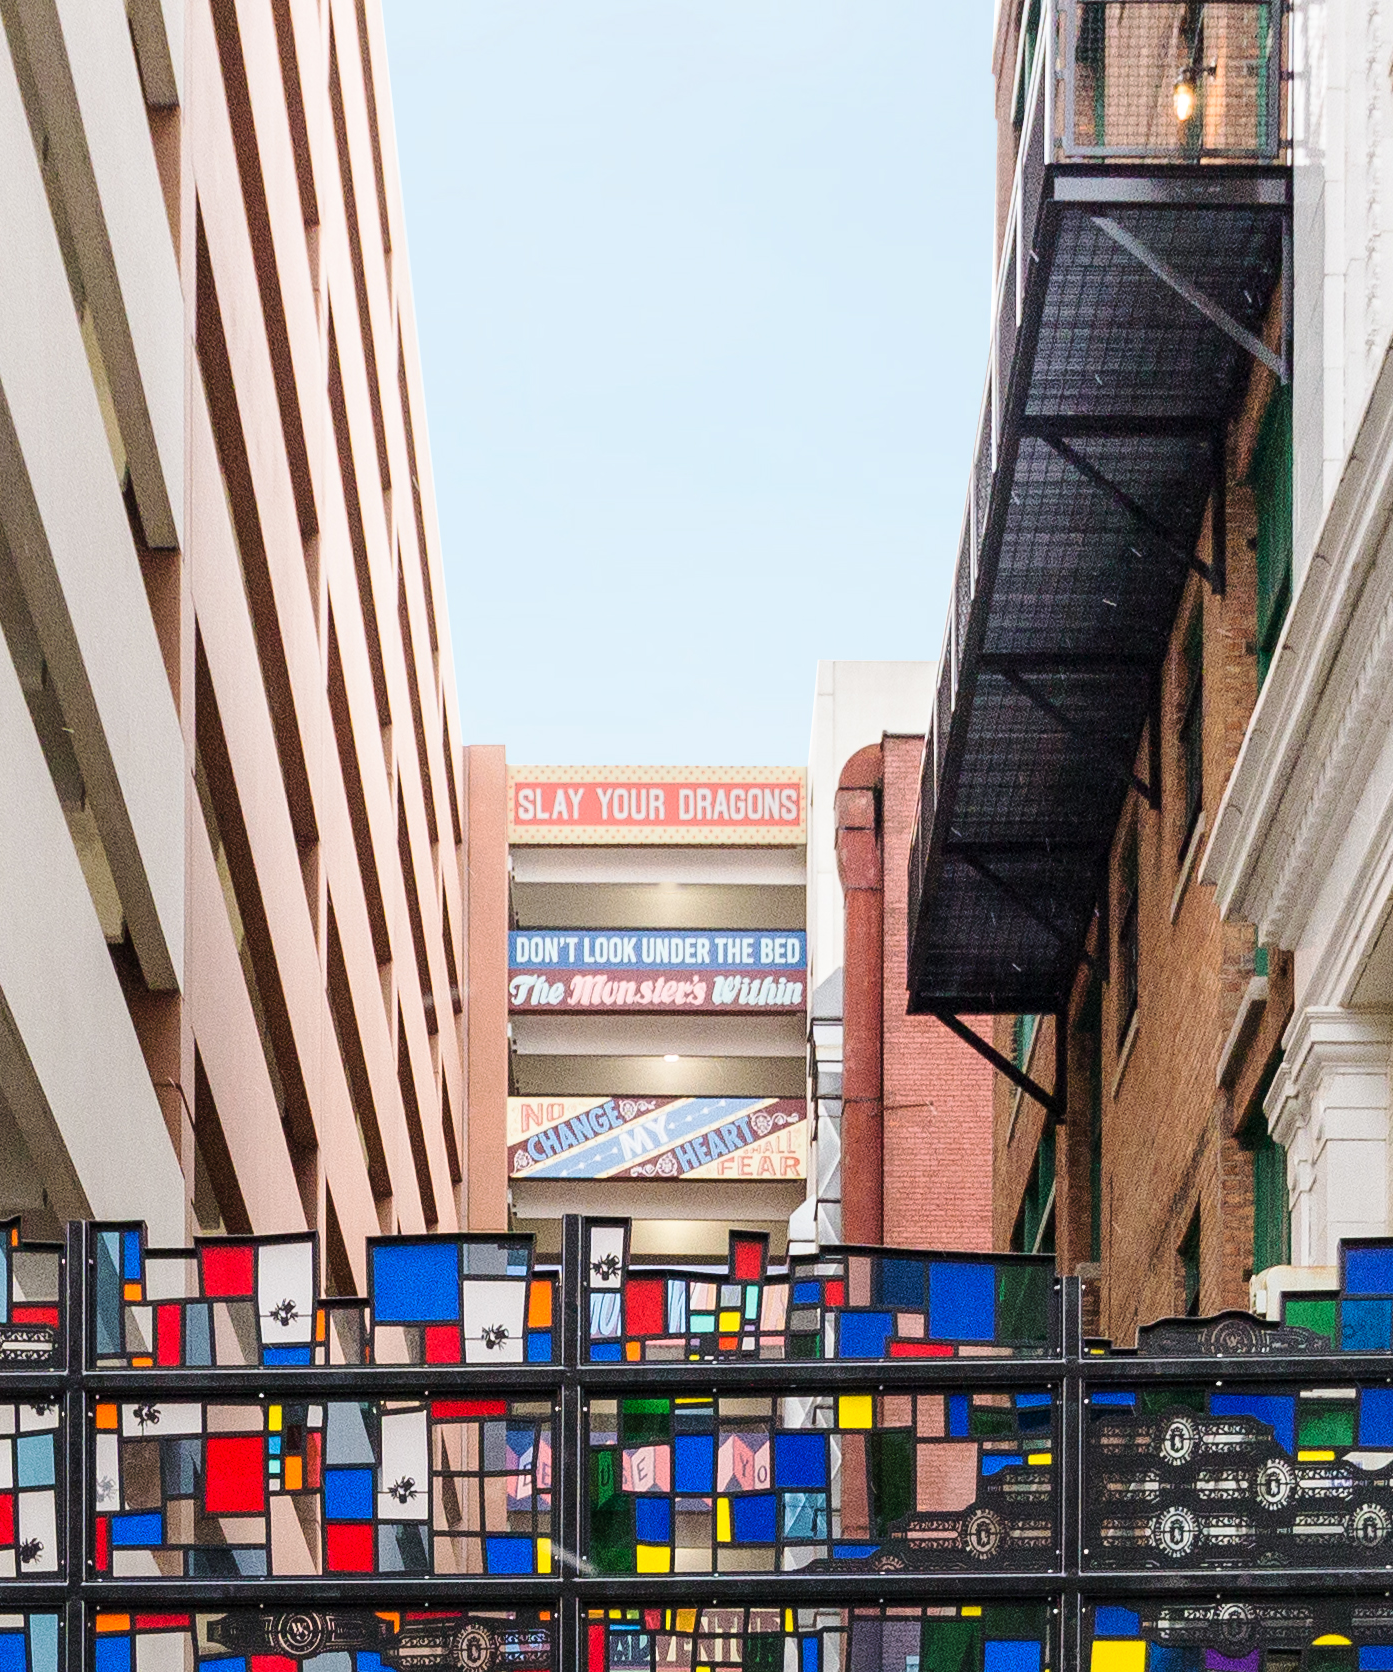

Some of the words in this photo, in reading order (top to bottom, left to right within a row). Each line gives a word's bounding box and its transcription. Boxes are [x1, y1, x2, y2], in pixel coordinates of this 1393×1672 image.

[517, 787, 583, 820] SLAY
[596, 787, 665, 820] YOUR
[678, 787, 798, 820] DRAGONS
[515, 936, 576, 964] DON'T
[583, 936, 635, 964] LOOK
[642, 936, 710, 964] UNDER
[716, 936, 755, 964] THE
[760, 936, 801, 964] BED
[508, 974, 565, 1005] The
[567, 974, 707, 1005] Monster's
[711, 974, 803, 1005] Within
[520, 1103, 564, 1132] NO
[526, 1099, 623, 1162] CHANGE
[618, 1114, 670, 1161] MY
[674, 1116, 754, 1173] HEART
[717, 1156, 801, 1176] FEAR
